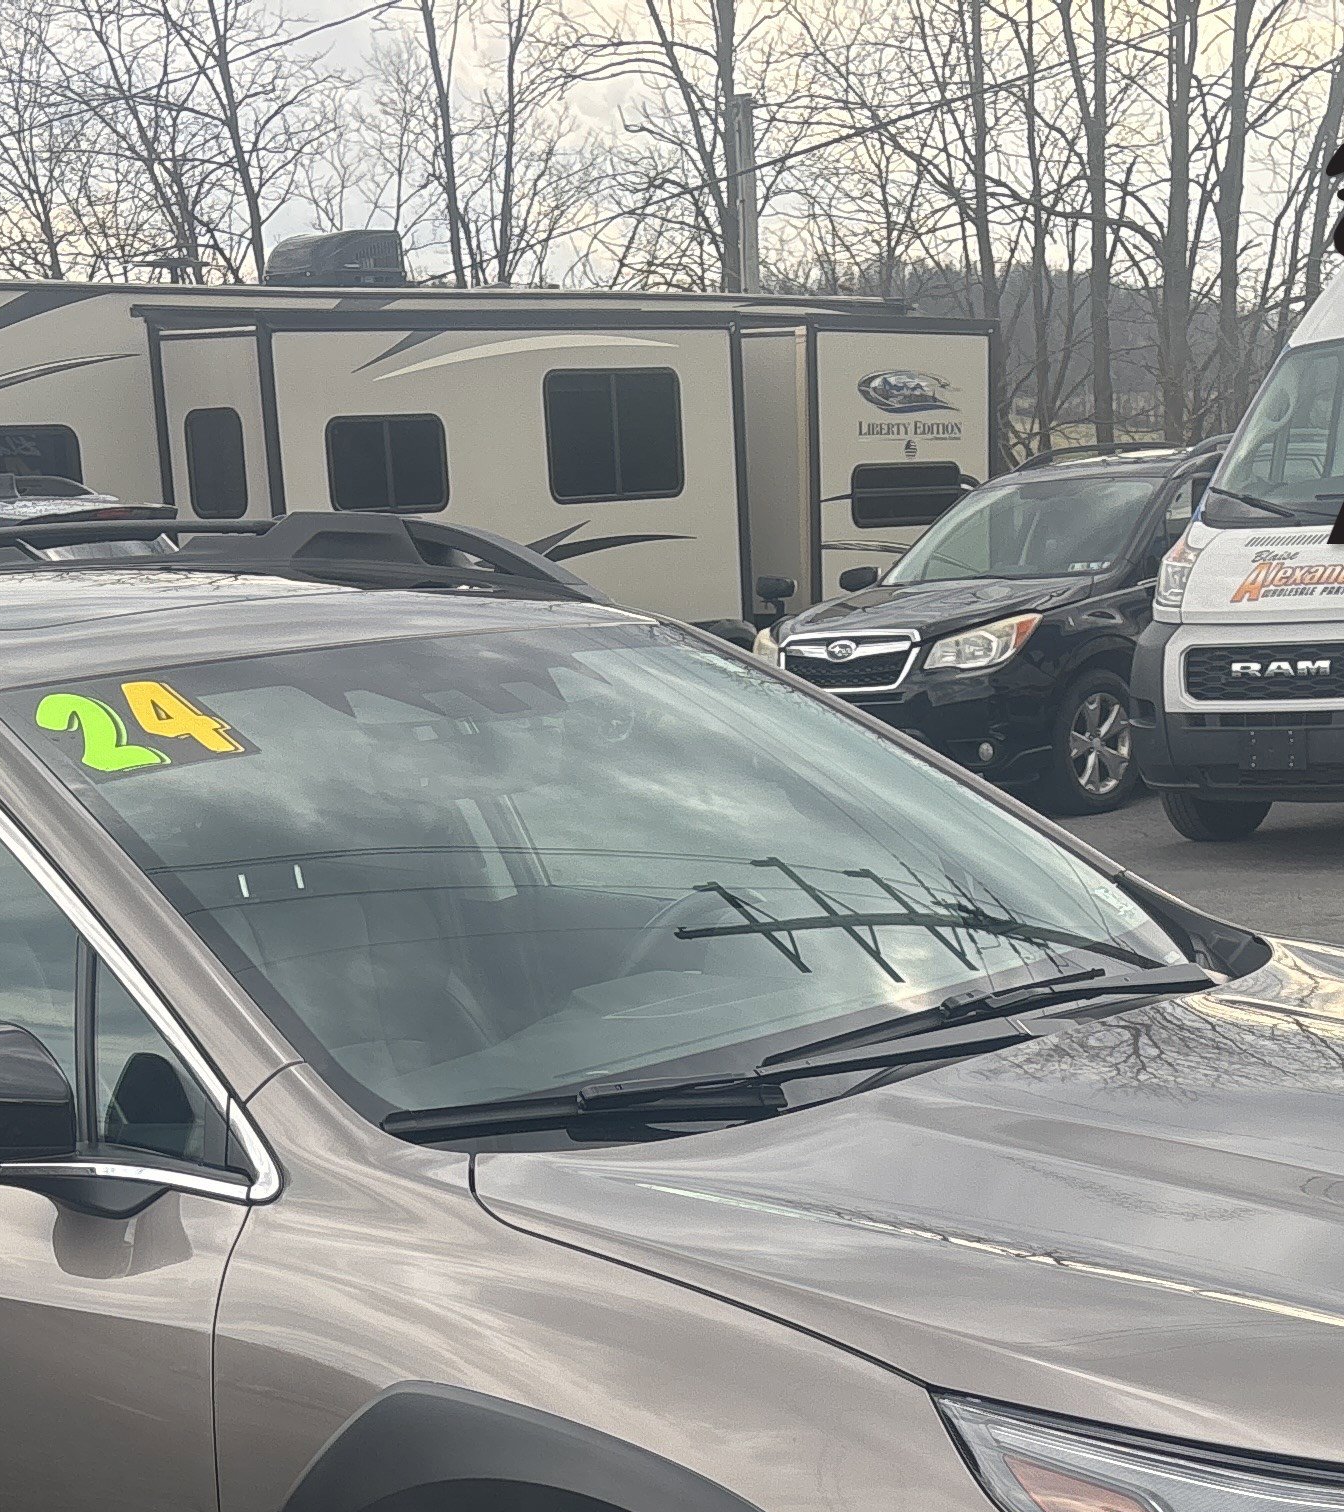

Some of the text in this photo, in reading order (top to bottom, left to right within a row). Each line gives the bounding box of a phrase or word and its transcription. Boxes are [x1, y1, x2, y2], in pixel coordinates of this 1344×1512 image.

[858, 420, 963, 437] LIBERTY EDITION
[1230, 659, 1332, 678] RAM
[35, 681, 246, 773] 24
